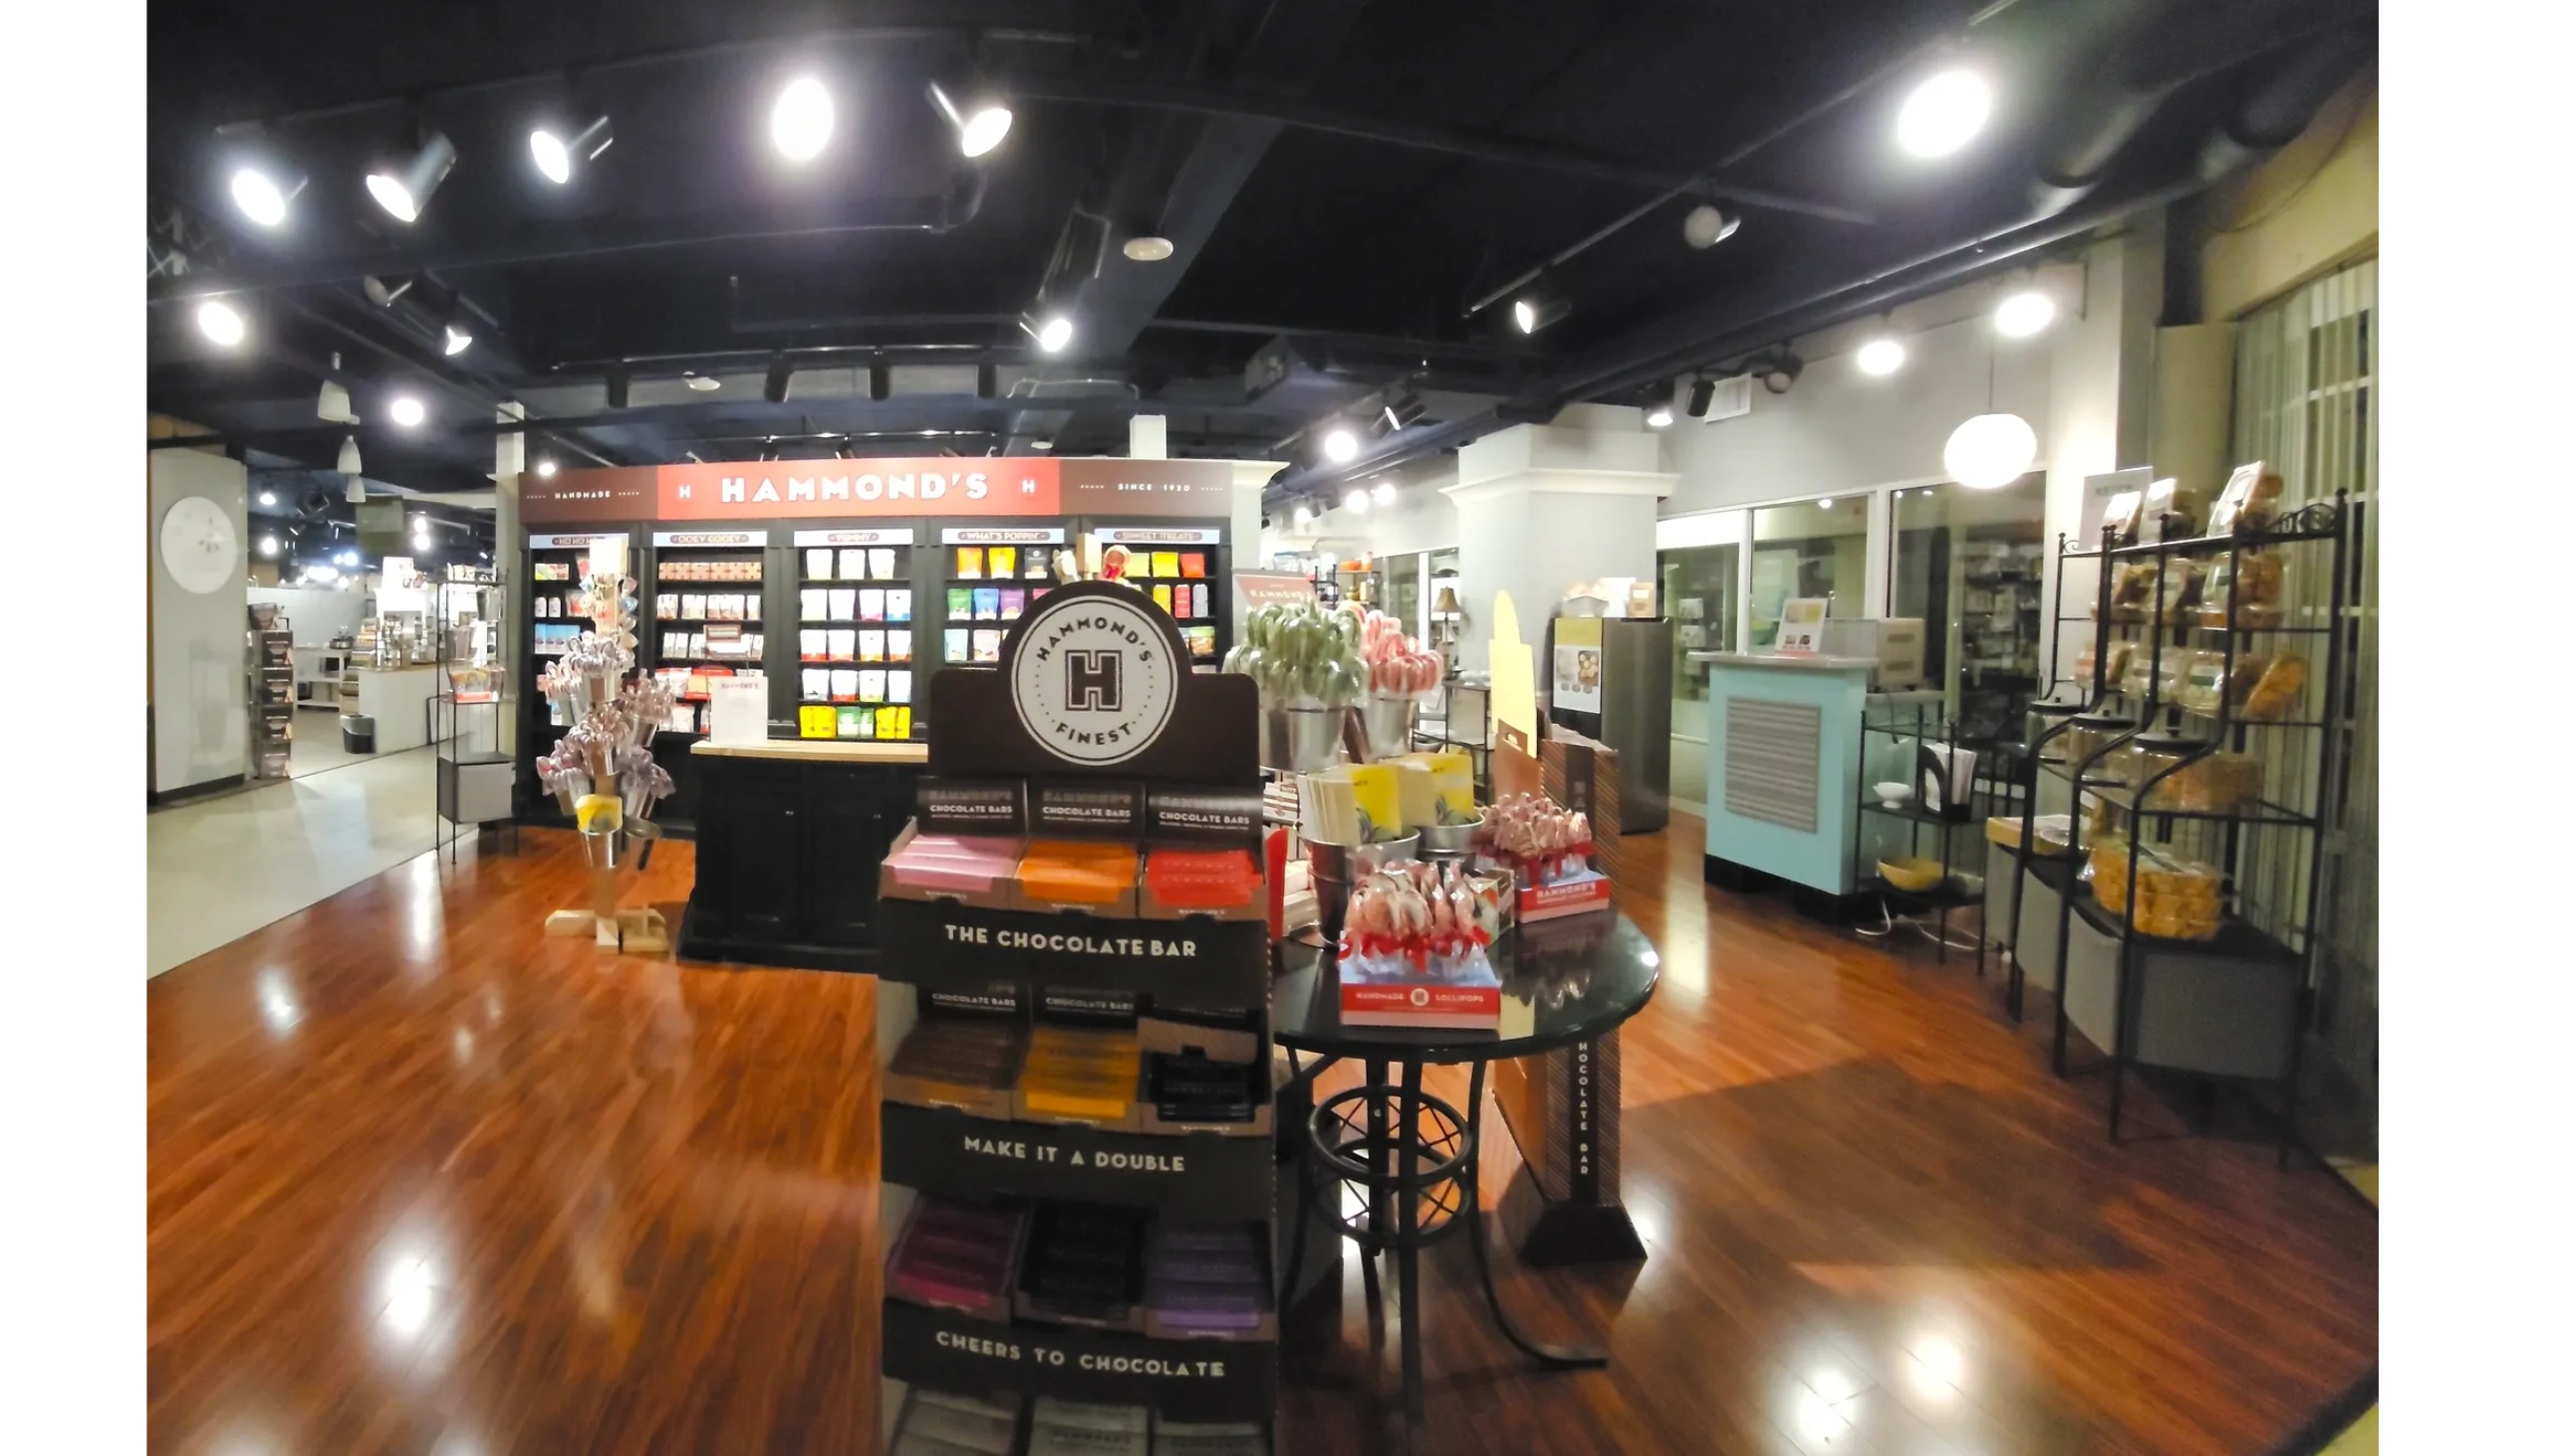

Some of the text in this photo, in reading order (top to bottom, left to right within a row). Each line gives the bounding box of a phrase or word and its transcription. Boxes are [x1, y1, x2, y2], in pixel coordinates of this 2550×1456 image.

[555, 490, 611, 499] HANDMADE
[678, 485, 691, 498] H
[721, 472, 988, 503] HAMMOND'S
[1022, 480, 1035, 494] H
[967, 532, 1002, 541] WHAT'S
[1037, 616, 1153, 662] HAMMOND'S
[1065, 649, 1123, 712] H
[1056, 722, 1133, 746] FINEST
[987, 805, 1013, 814] BARS
[1043, 806, 1132, 818] CHOCOLATE BARS
[1159, 812, 1250, 825] CHOCOLATE BARS
[945, 924, 1196, 957] THE CHOCOLATE BAR
[1579, 1042, 1589, 1175] HOCOLATE BAR
[964, 1136, 1185, 1172] MAKE IT A DOUBLE
[935, 1331, 1225, 1377] CHEERS TO CHOCOLATE
